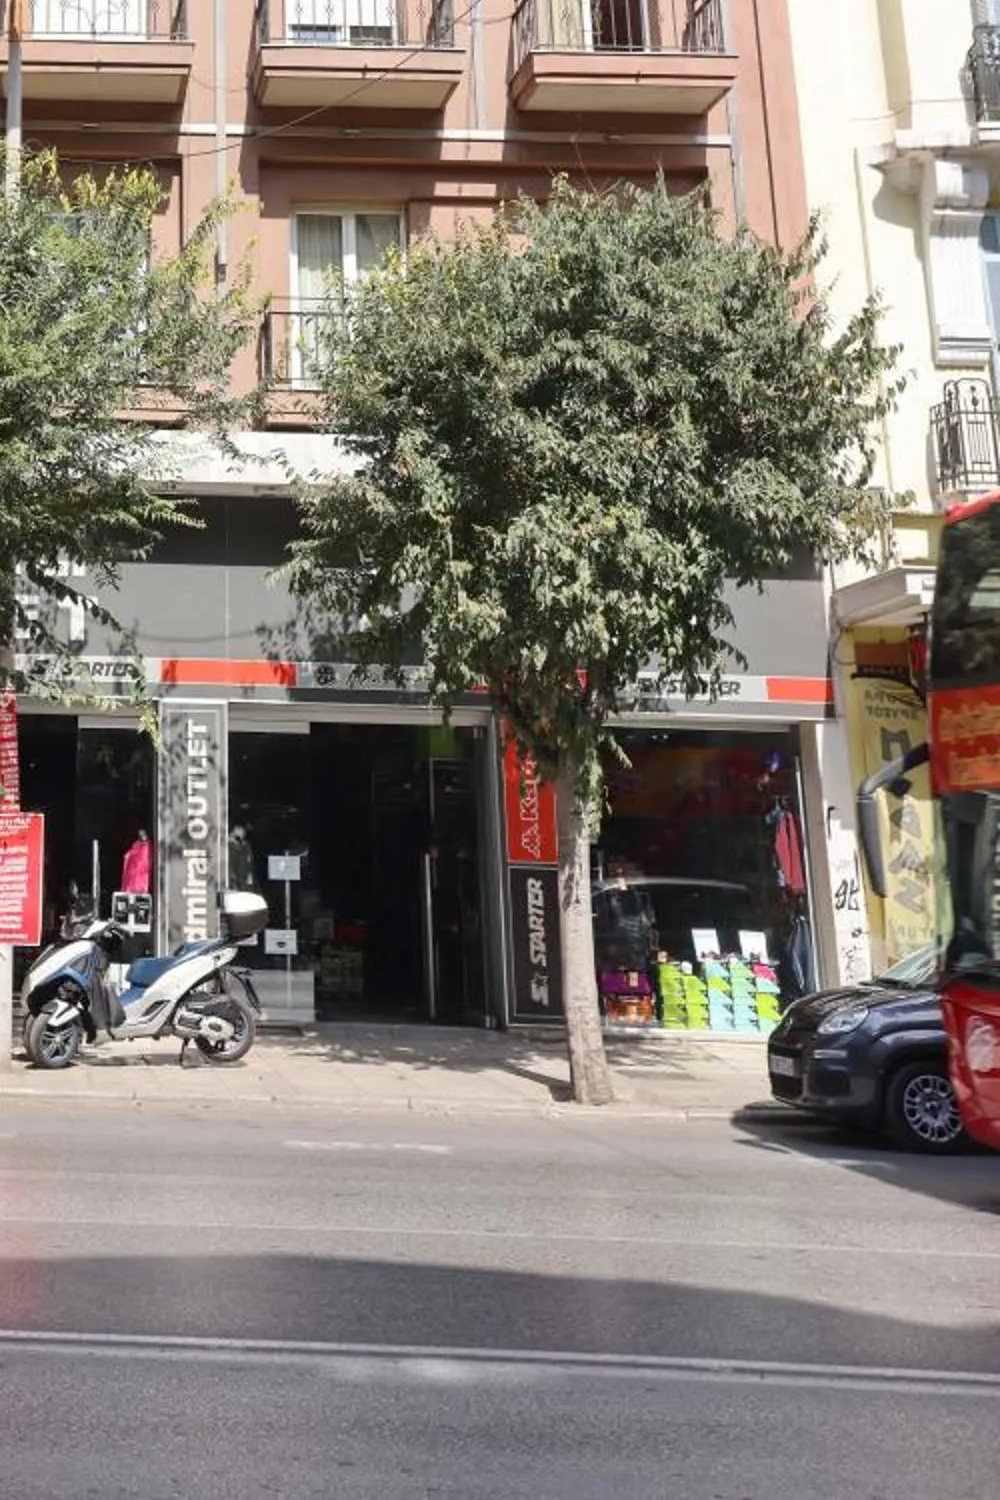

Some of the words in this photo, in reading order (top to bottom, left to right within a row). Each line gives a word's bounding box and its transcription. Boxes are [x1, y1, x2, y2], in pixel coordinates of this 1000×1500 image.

[187, 719, 209, 840] OUTLET
[182, 849, 208, 943] dmiral
[527, 877, 547, 967] STARTER
